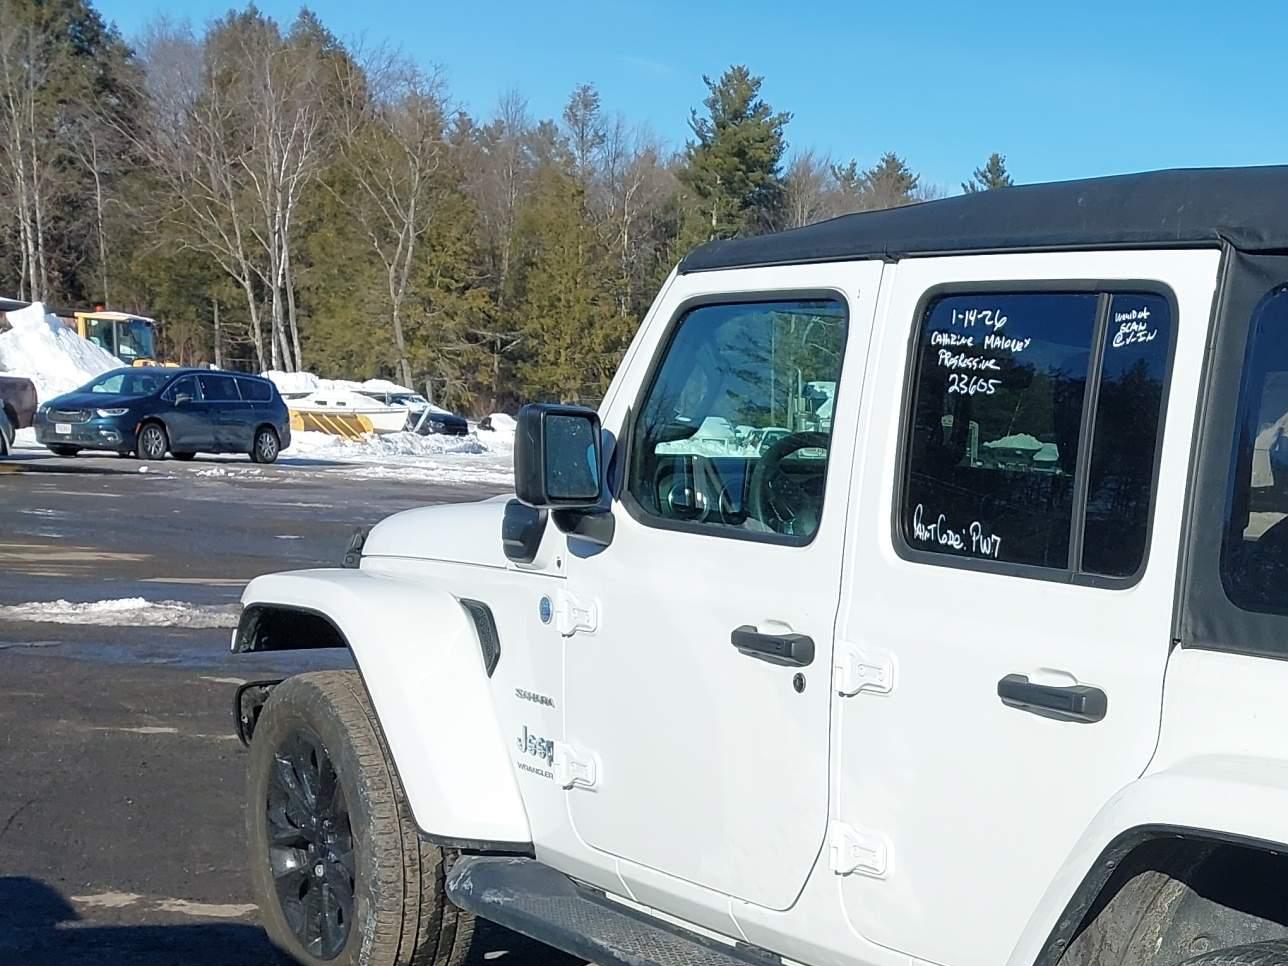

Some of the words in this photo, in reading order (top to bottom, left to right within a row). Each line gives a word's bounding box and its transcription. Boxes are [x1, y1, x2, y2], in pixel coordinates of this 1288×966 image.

[952, 308, 1008, 332] 1-14-26
[947, 373, 1003, 396] 23605
[516, 725, 555, 767] Jeep
[517, 761, 555, 780] WRANGLER
